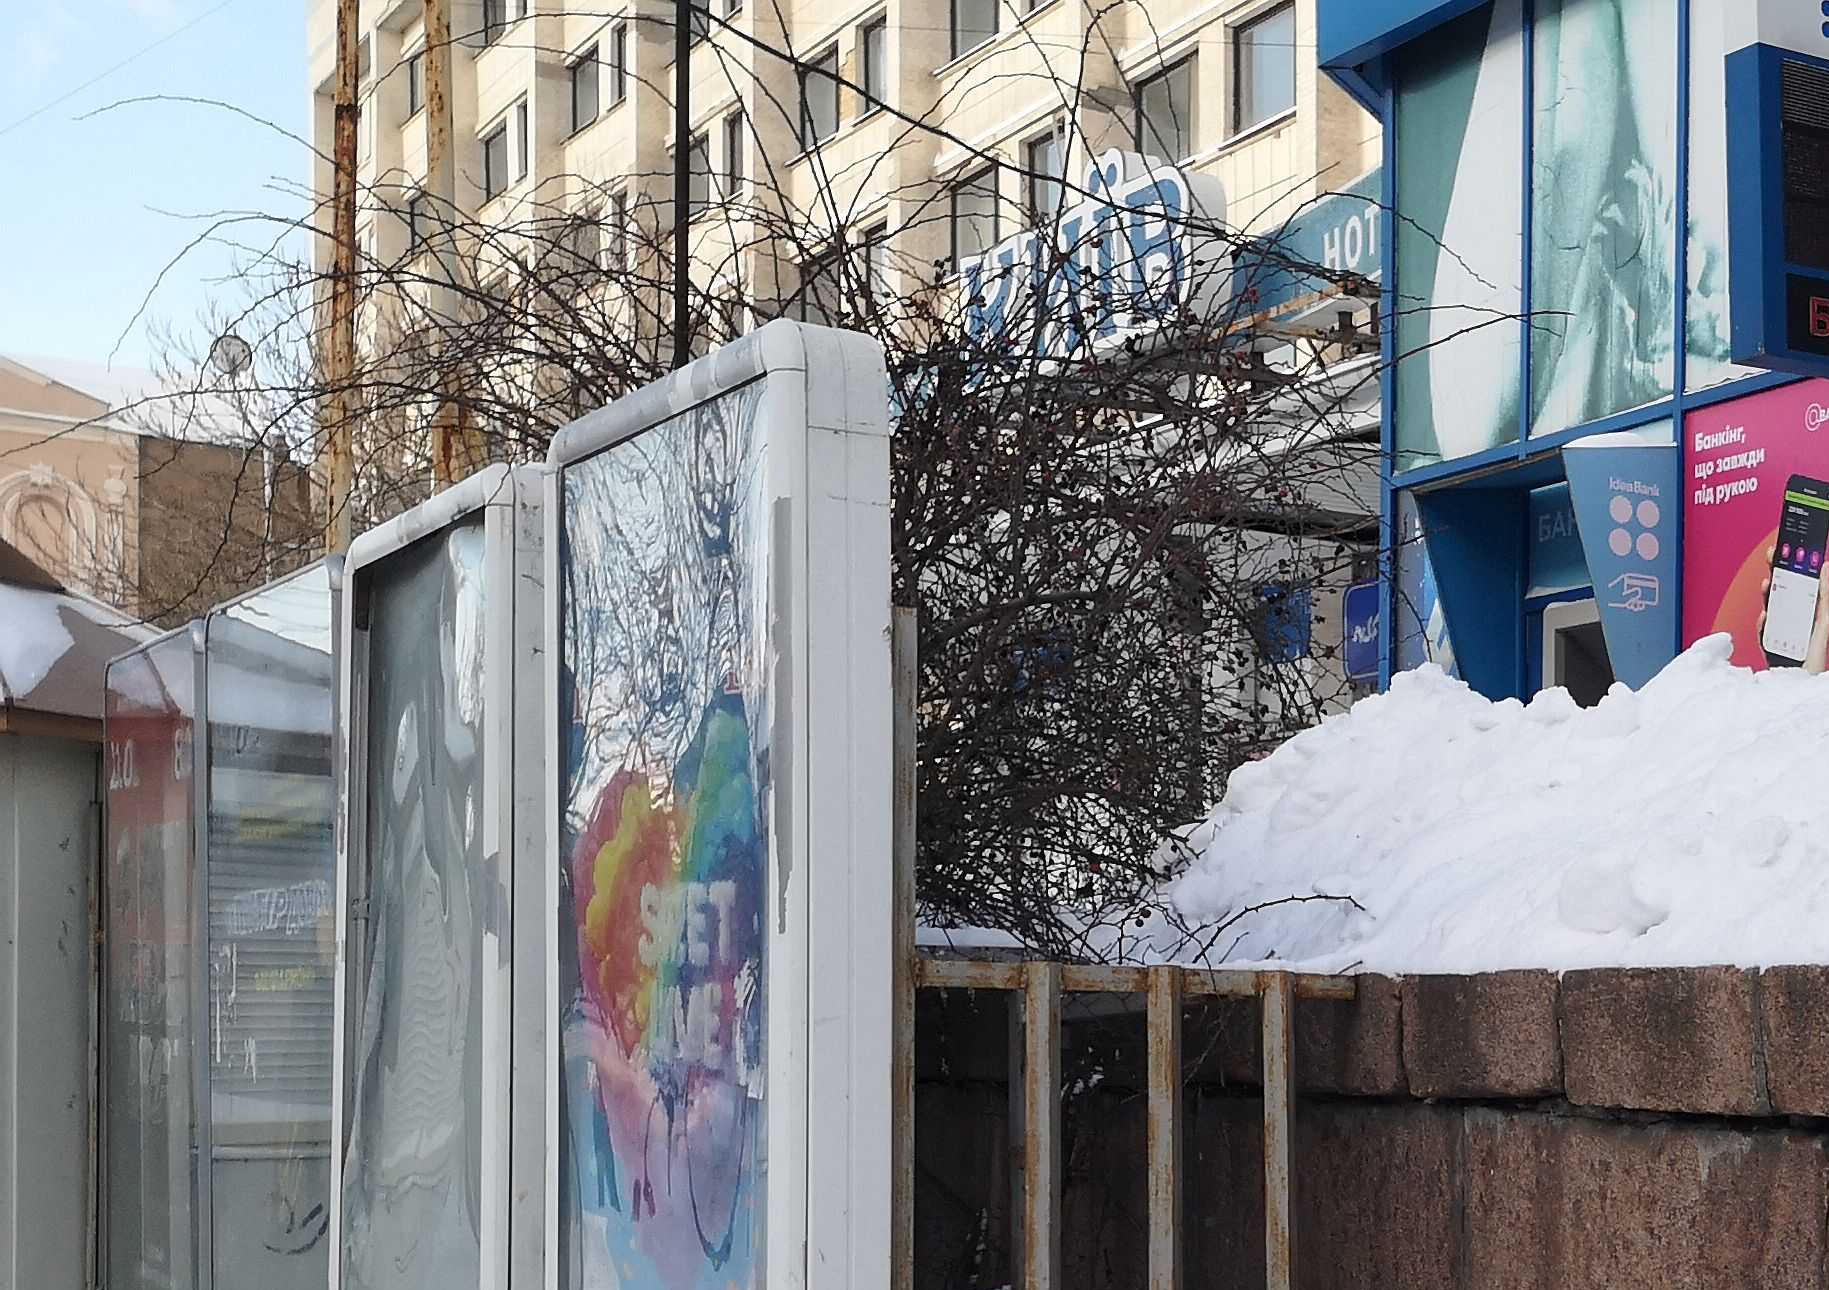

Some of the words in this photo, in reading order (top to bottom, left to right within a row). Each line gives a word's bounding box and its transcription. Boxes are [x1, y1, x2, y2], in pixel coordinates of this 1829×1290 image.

[1695, 425, 1746, 452] Банкінг,
[1695, 462, 1714, 479] що
[1716, 448, 1765, 473] завжди
[1695, 484, 1713, 506] під
[1715, 477, 1758, 504] рукою
